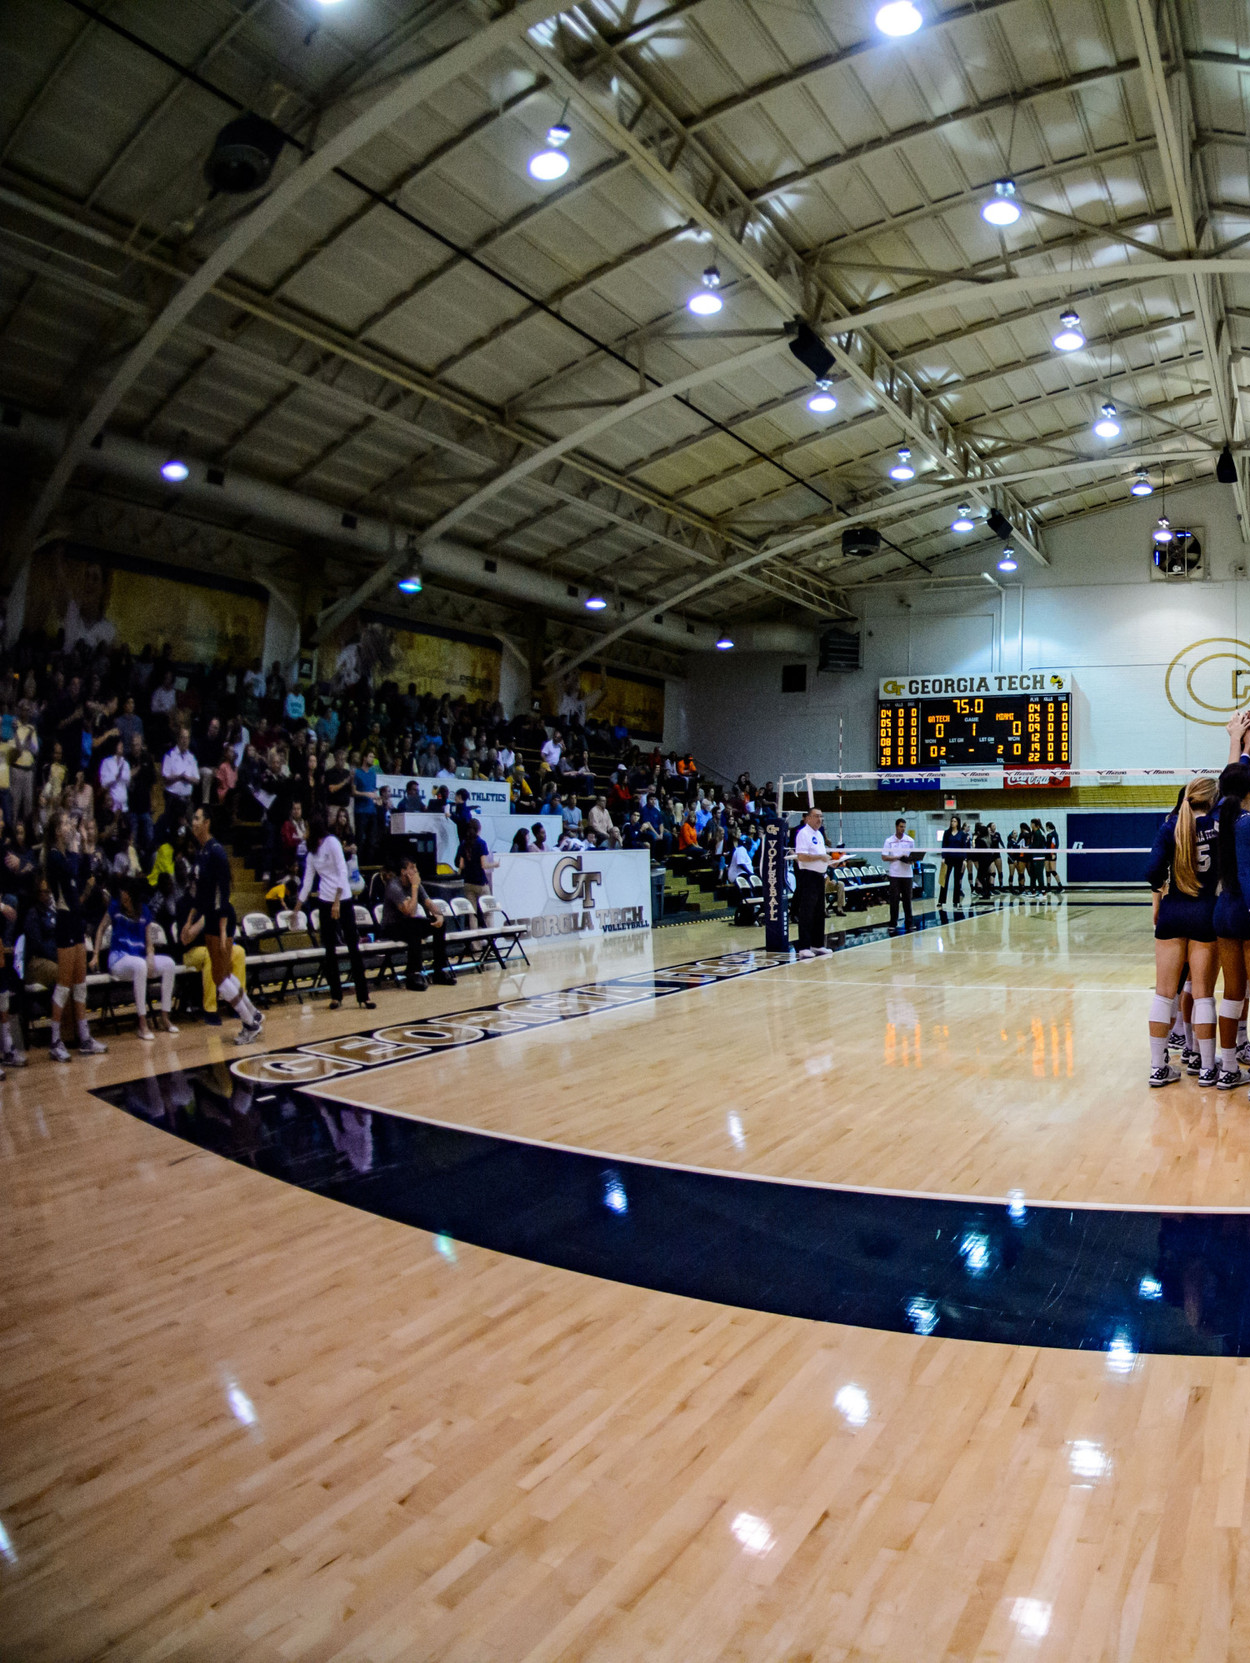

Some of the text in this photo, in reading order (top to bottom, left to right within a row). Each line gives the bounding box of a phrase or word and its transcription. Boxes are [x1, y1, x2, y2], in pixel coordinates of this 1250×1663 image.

[908, 677, 990, 695] GEORGIA
[994, 675, 1045, 691] TECH
[953, 699, 984, 713] 75.0
[1028, 703, 1068, 712] 04 0 0
[881, 708, 917, 718] 04 0 0
[1028, 712, 1068, 722] 05 0 0
[881, 718, 917, 727] 05 0 0
[1028, 722, 1068, 732] 09 0 0
[881, 727, 917, 737] 07 0 0
[936, 724, 944, 738] 0
[972, 723, 976, 736] 1
[1013, 721, 1021, 735] 0
[881, 737, 916, 746] 08 0 0
[1031, 732, 1068, 742] 12 0 0
[883, 746, 916, 756] 18 0 0
[930, 746, 946, 757] 0 2
[997, 743, 1021, 755] 2 0
[1031, 742, 1068, 751] 19 0 0
[881, 756, 916, 766] 33 0 0
[1028, 752, 1068, 762] 22 0 0
[553, 856, 601, 908] GT
[768, 840, 778, 921] VOLLEYBALL
[596, 906, 644, 930] TECH
[602, 920, 650, 932] VOLLEYBALL
